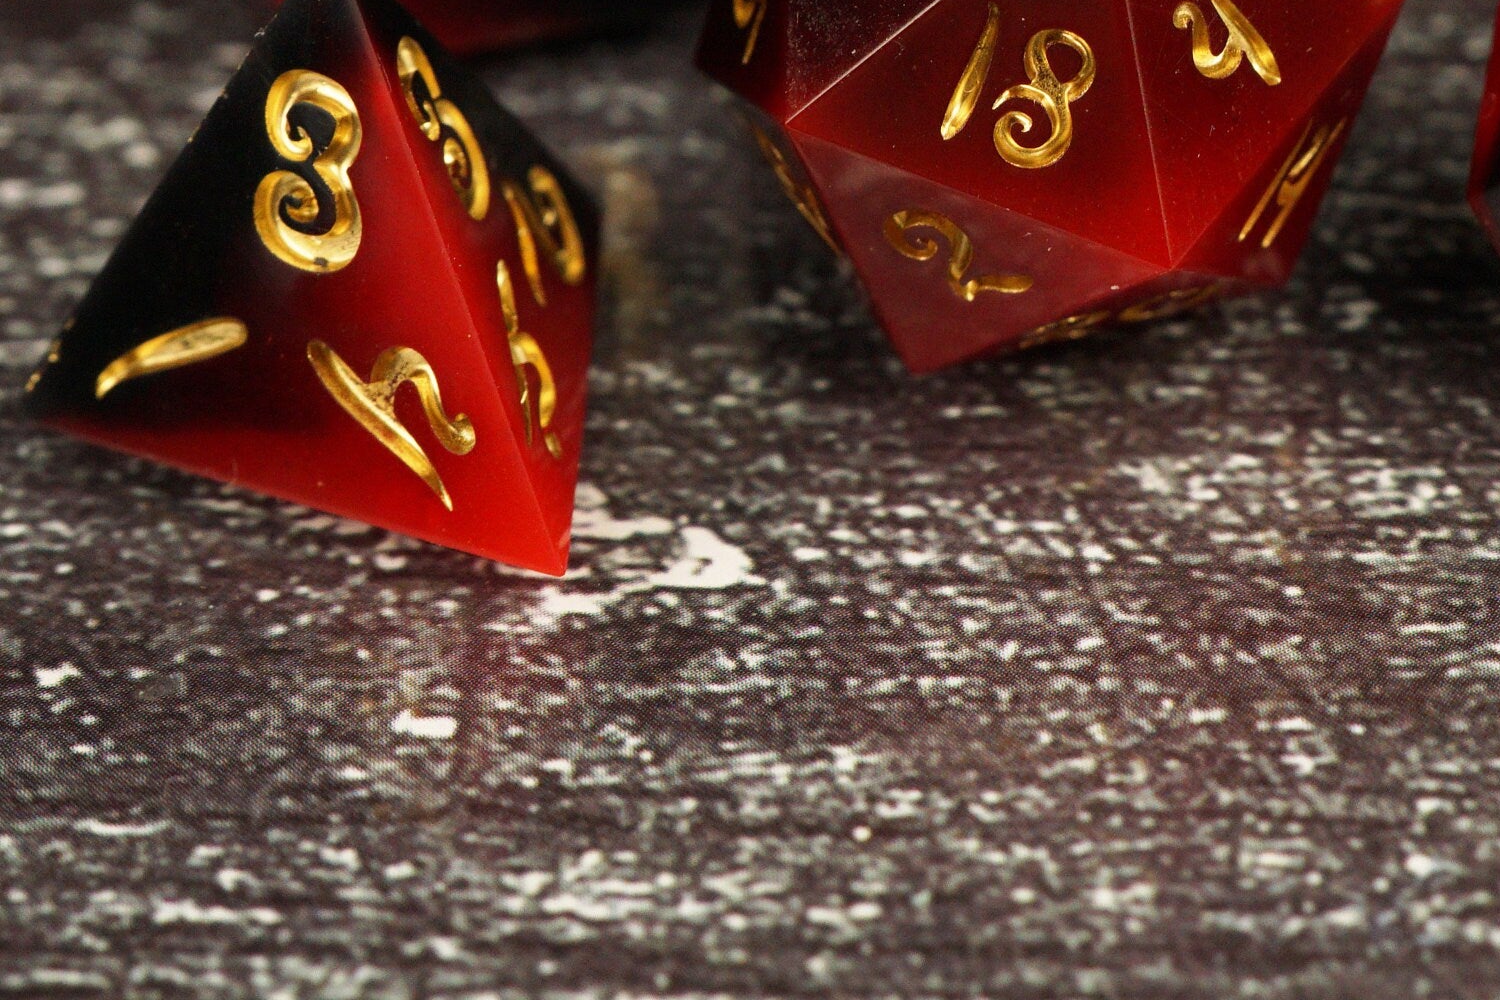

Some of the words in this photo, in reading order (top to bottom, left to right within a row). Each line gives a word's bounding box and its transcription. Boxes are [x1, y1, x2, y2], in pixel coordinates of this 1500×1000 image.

[398, 36, 489, 220] 3
[941, 1, 1096, 168] 18
[253, 69, 362, 272] 3
[883, 210, 1033, 301] 2
[95, 316, 248, 400] 1
